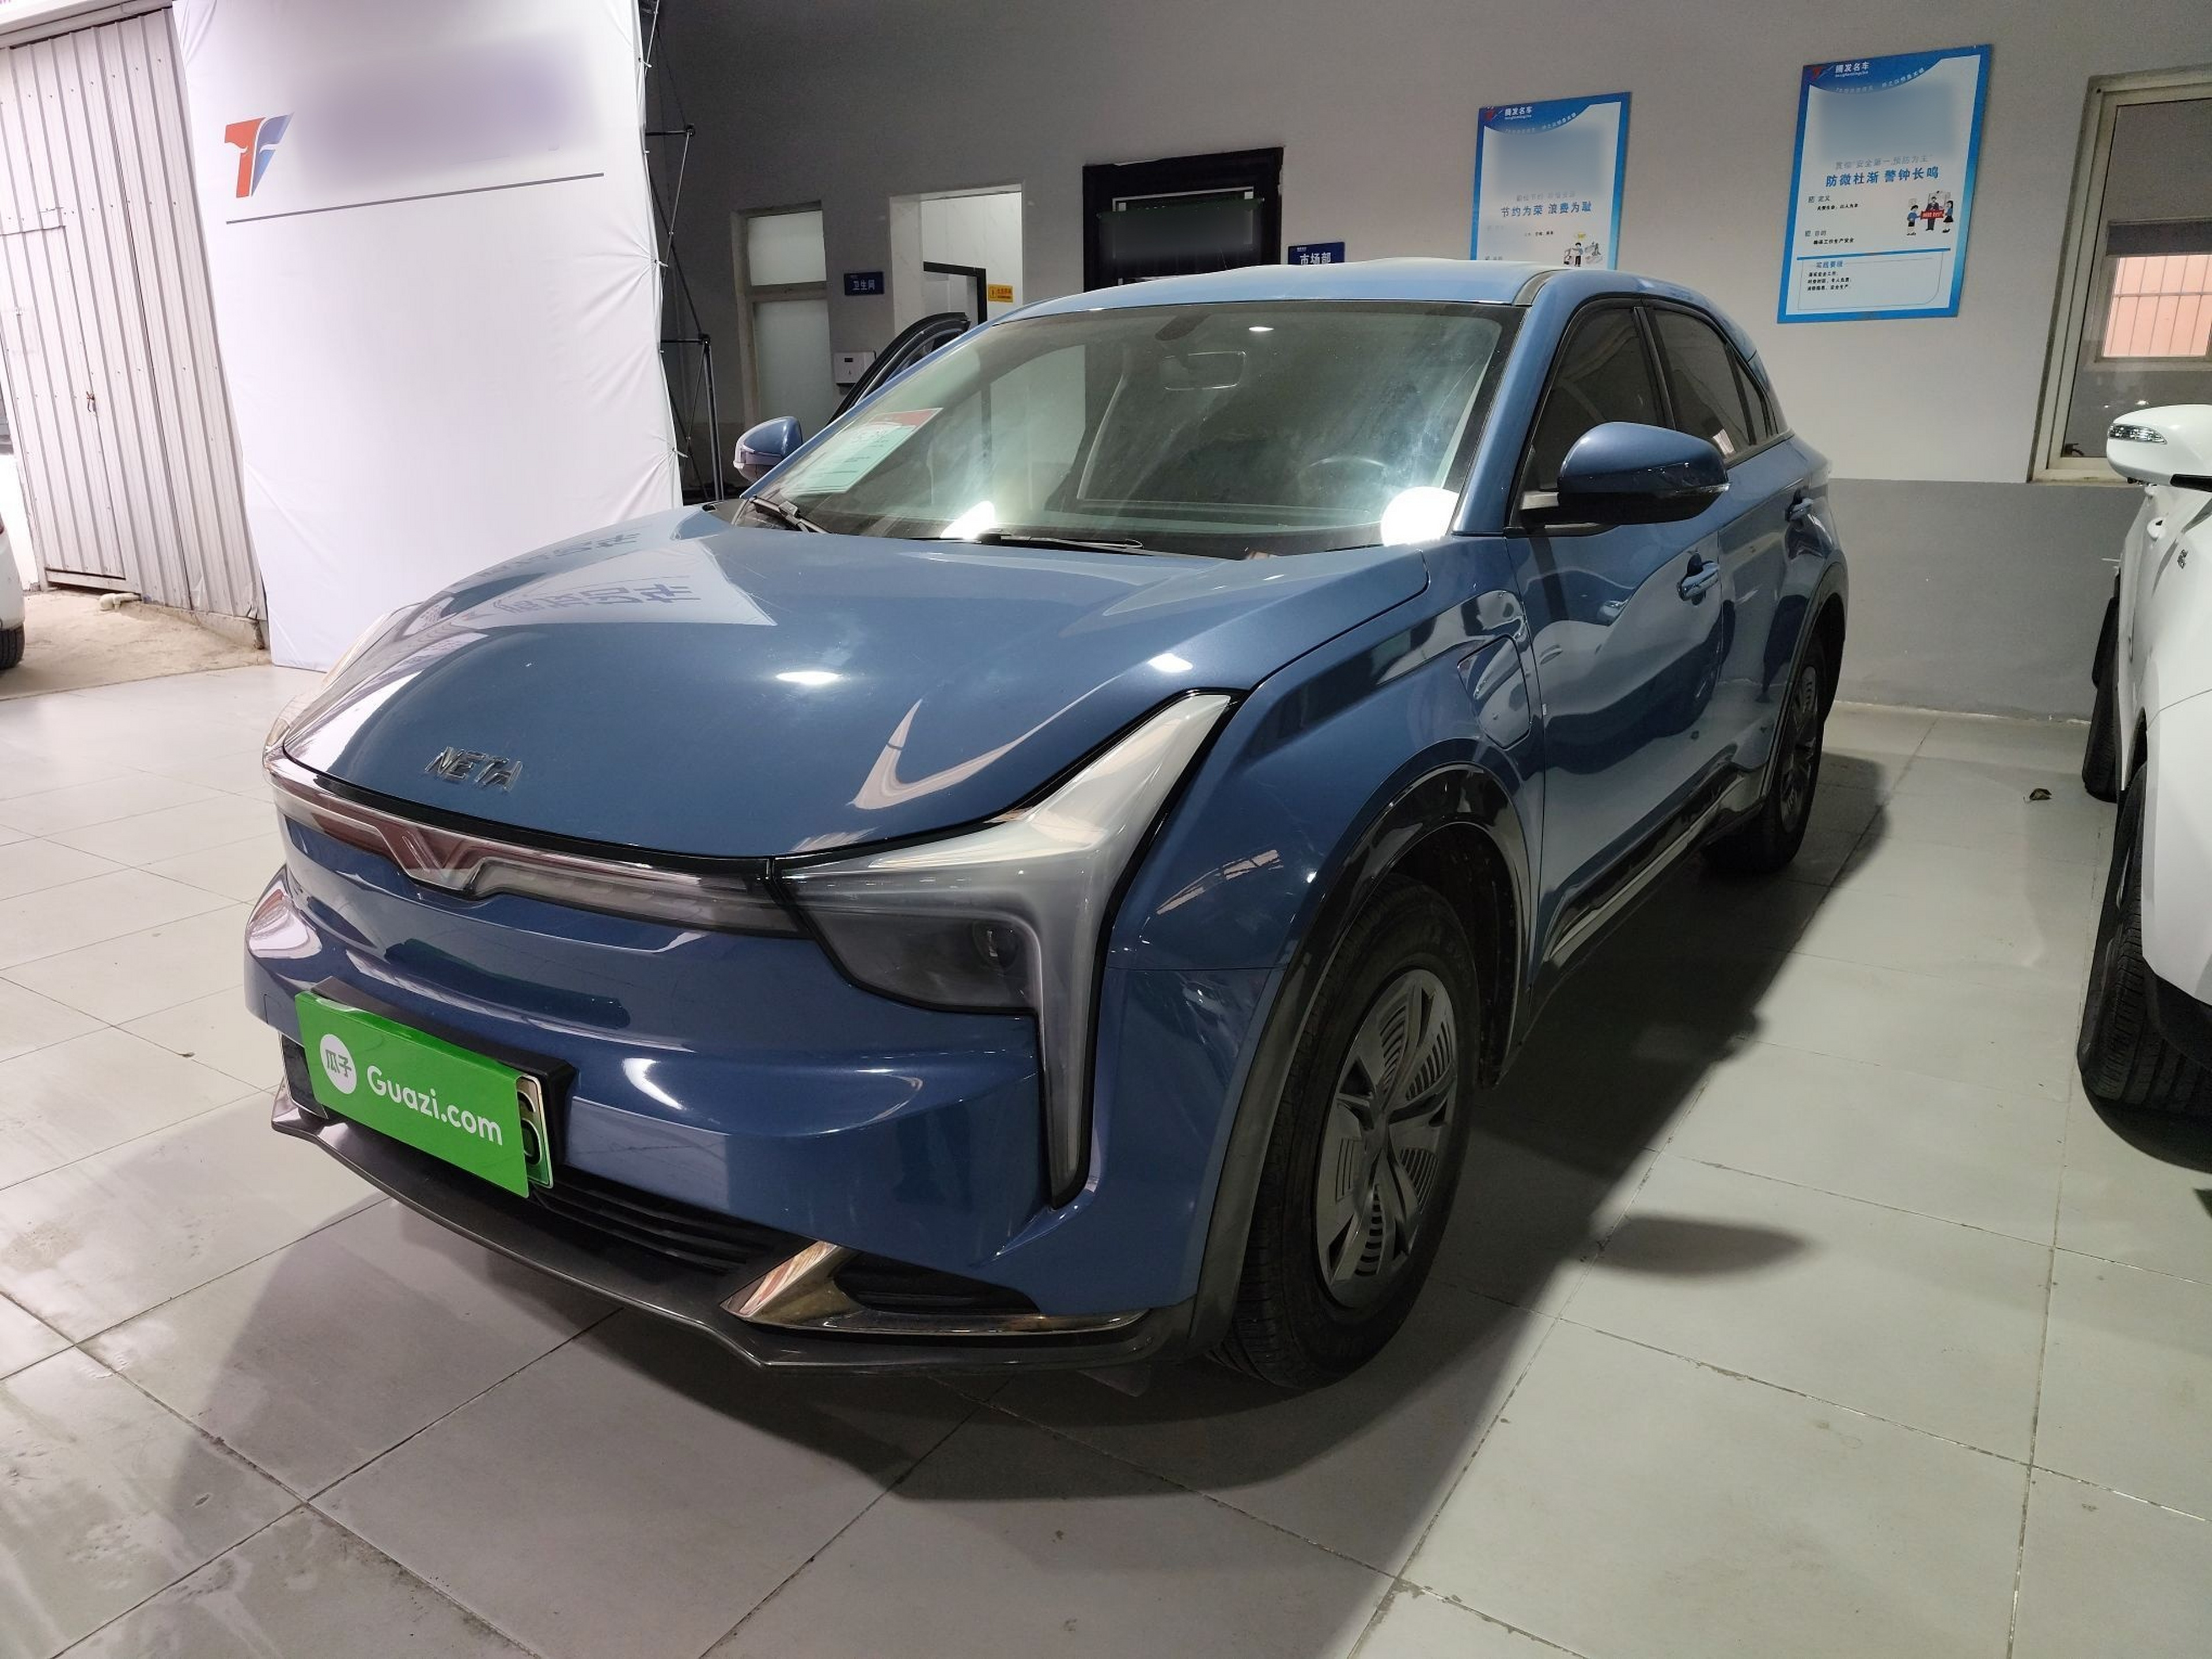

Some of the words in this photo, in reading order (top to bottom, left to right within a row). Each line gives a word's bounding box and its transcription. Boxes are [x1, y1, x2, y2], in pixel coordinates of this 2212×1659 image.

[1825, 171, 1879, 187] 防微杜渐
[1884, 166, 1939, 183] 警钟长鸣
[1501, 204, 1543, 217] 节约为荣
[1548, 201, 1592, 214] 浪费为耻
[1300, 252, 1331, 265] 市场部
[325, 1048, 352, 1078] 瓜子
[367, 1065, 503, 1146] Guazi.com
